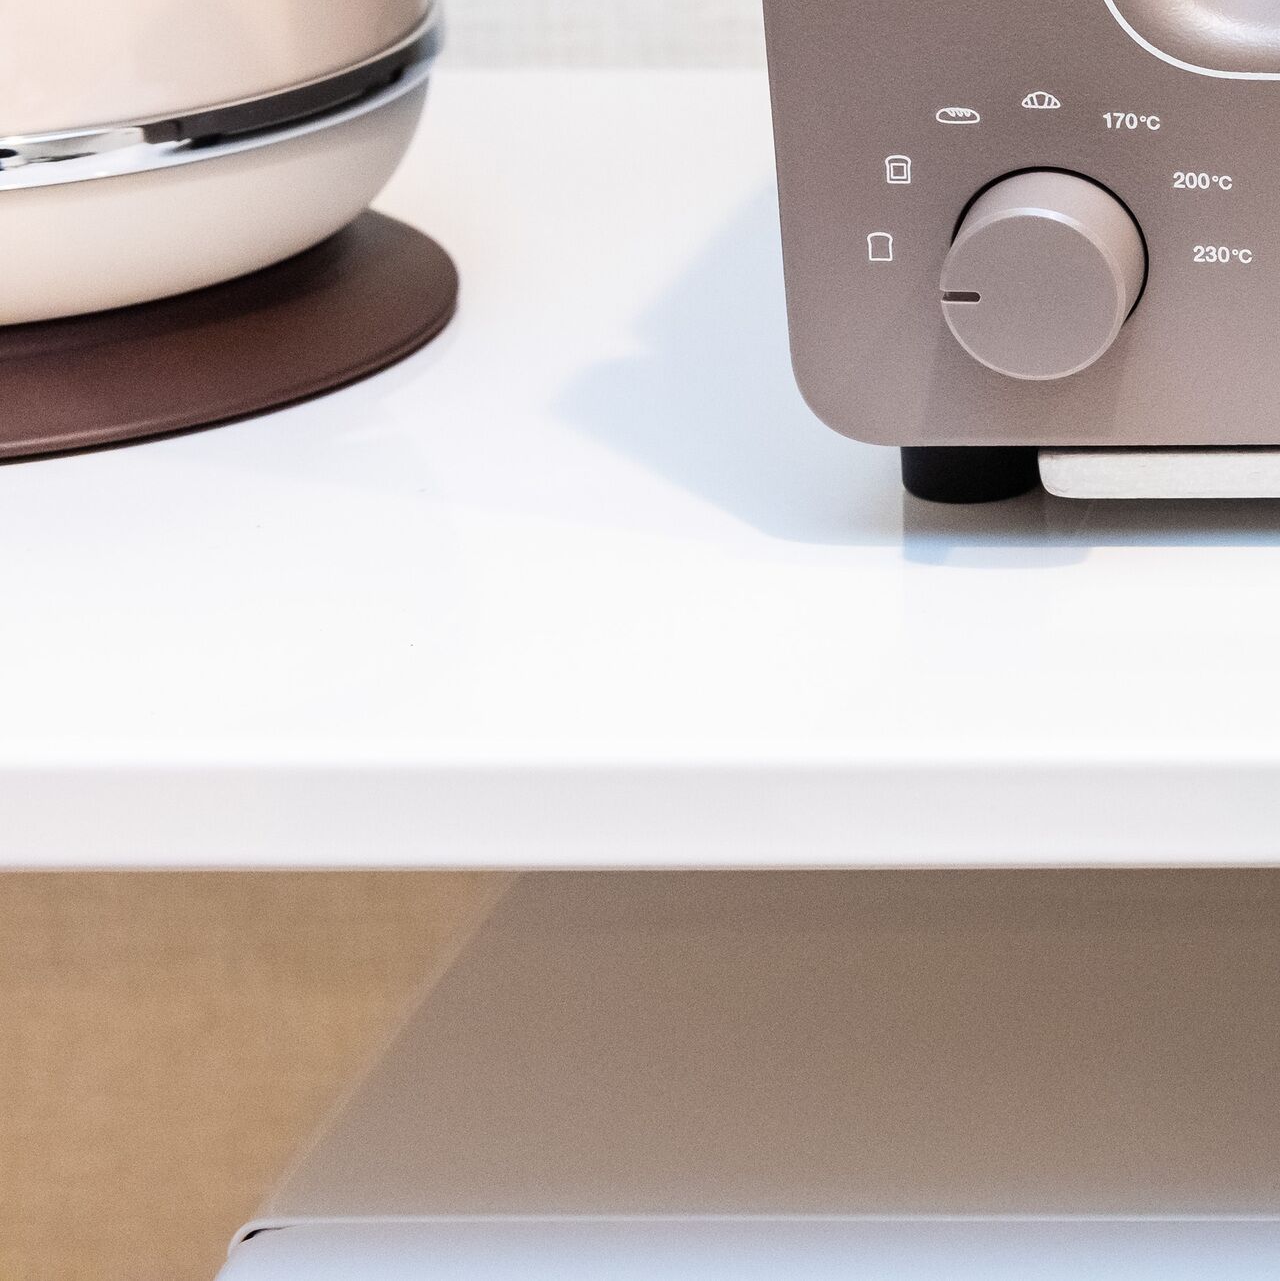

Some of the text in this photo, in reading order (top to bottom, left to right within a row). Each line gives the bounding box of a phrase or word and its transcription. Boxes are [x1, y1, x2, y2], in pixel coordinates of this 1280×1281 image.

[1103, 113, 1161, 131] 170°C
[1173, 172, 1233, 190] 200°C
[1193, 246, 1252, 264] 230°C
